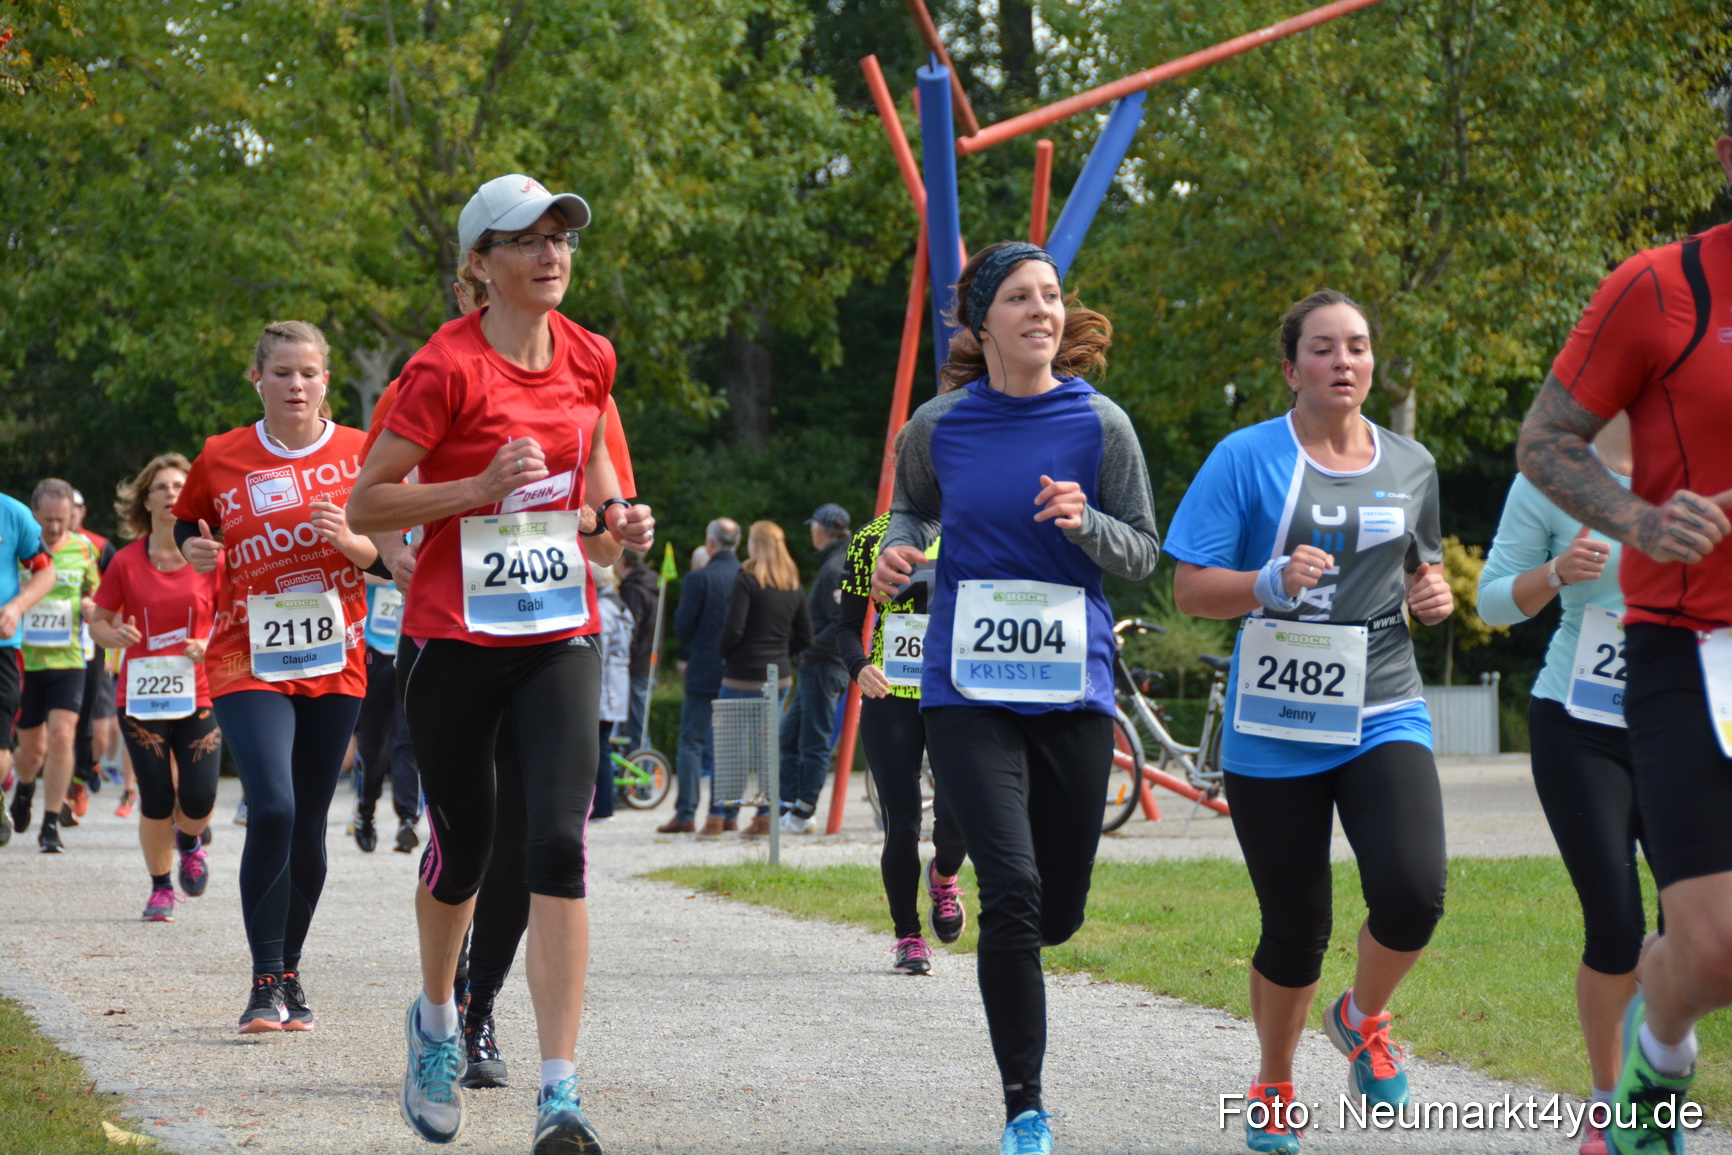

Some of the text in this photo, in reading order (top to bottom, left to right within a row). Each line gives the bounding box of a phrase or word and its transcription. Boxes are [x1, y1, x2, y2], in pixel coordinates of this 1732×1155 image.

[249, 468, 291, 485] raumbox
[522, 485, 554, 502] DEHN
[512, 522, 548, 534] BOCK
[228, 522, 329, 569] umbo
[251, 557, 292, 577] wohnen
[301, 546, 341, 562] outdoo
[483, 547, 568, 587] 2408
[279, 572, 322, 588] raumbox
[285, 600, 319, 608] BOCK
[518, 597, 544, 612] Gabi
[1006, 592, 1048, 603] BOCK
[381, 603, 399, 617] 27
[31, 614, 66, 628] 2774
[264, 616, 333, 647] 2118
[973, 617, 1066, 654] 2904
[1288, 633, 1332, 647] BOCK
[895, 636, 923, 658] 26
[282, 652, 317, 665] Claudia
[970, 663, 1052, 680] KRISSIE
[1257, 655, 1346, 697] 2482
[1580, 667, 1585, 675] D
[136, 676, 184, 695] 2225
[151, 700, 170, 709] Birgit
[1279, 706, 1316, 723] Jenny
